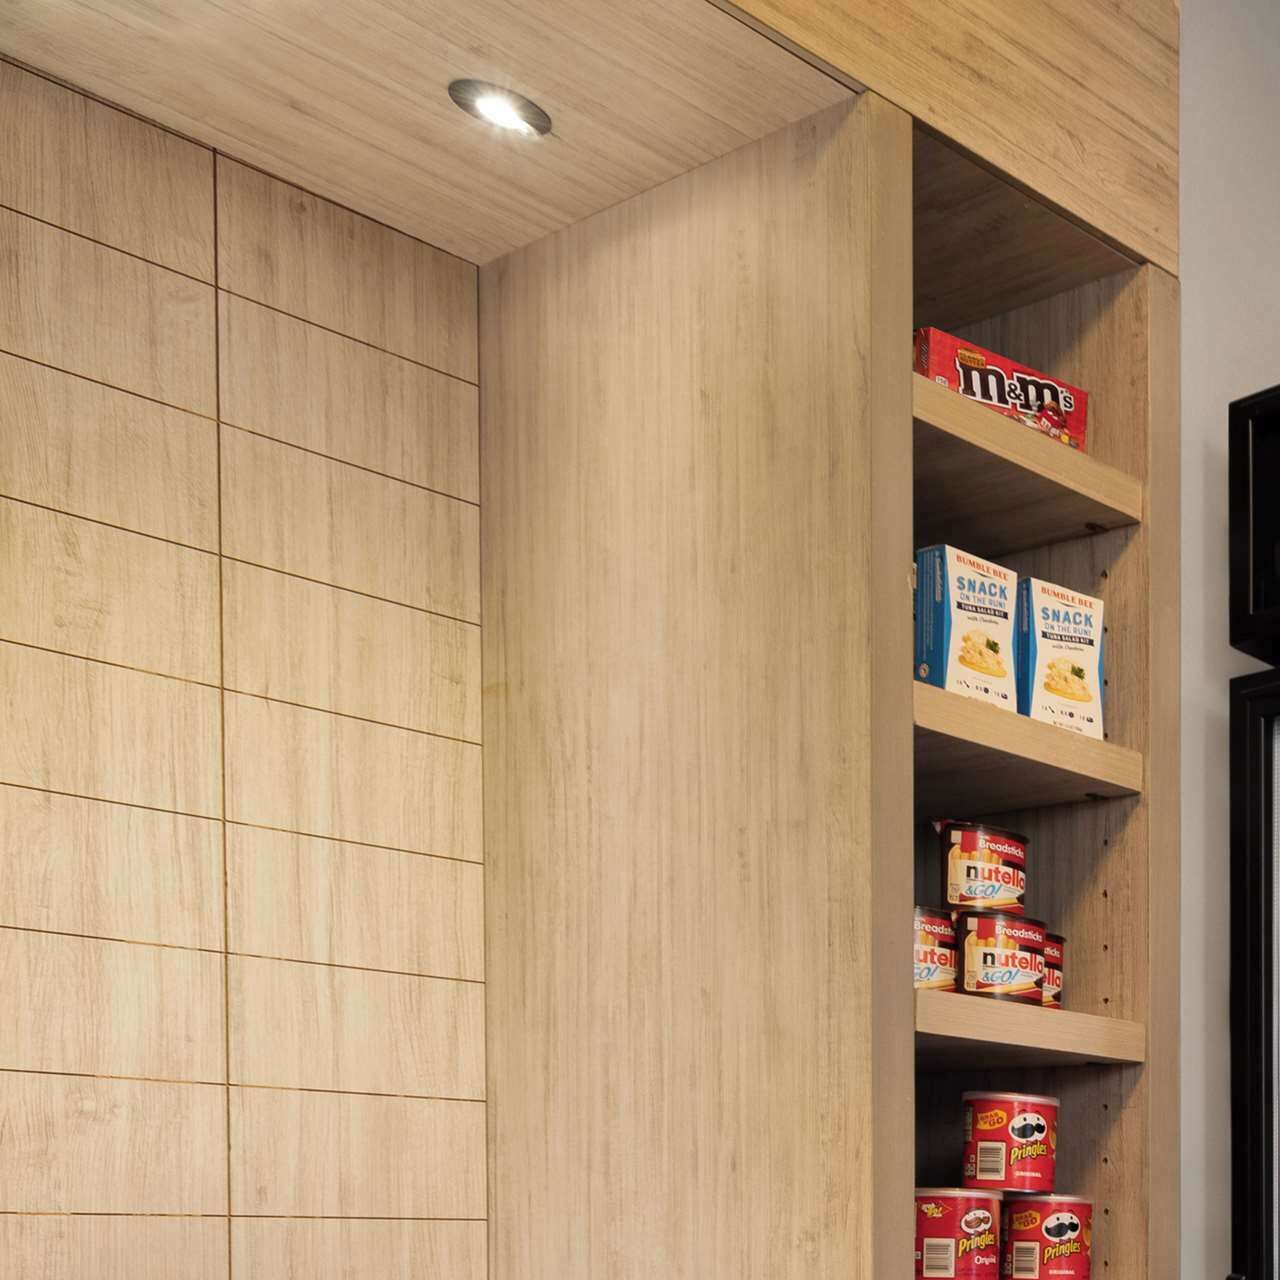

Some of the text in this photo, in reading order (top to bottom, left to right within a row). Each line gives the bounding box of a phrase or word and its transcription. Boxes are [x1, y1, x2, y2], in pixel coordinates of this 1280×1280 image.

[956, 554, 1008, 581] BUMBLE BEE
[957, 576, 1008, 599] SNACK
[1041, 586, 1094, 609] BUMBLE BEE
[1042, 608, 1093, 627] SNACK
[979, 839, 1024, 858] Breadsticks
[966, 864, 1025, 889] nutella
[995, 921, 1042, 942] Breadsticks
[983, 952, 1043, 972] nutella
[1010, 1140, 1047, 1165] Pringles
[959, 1231, 995, 1257] Pringles
[1044, 1240, 1081, 1264] Pringles
